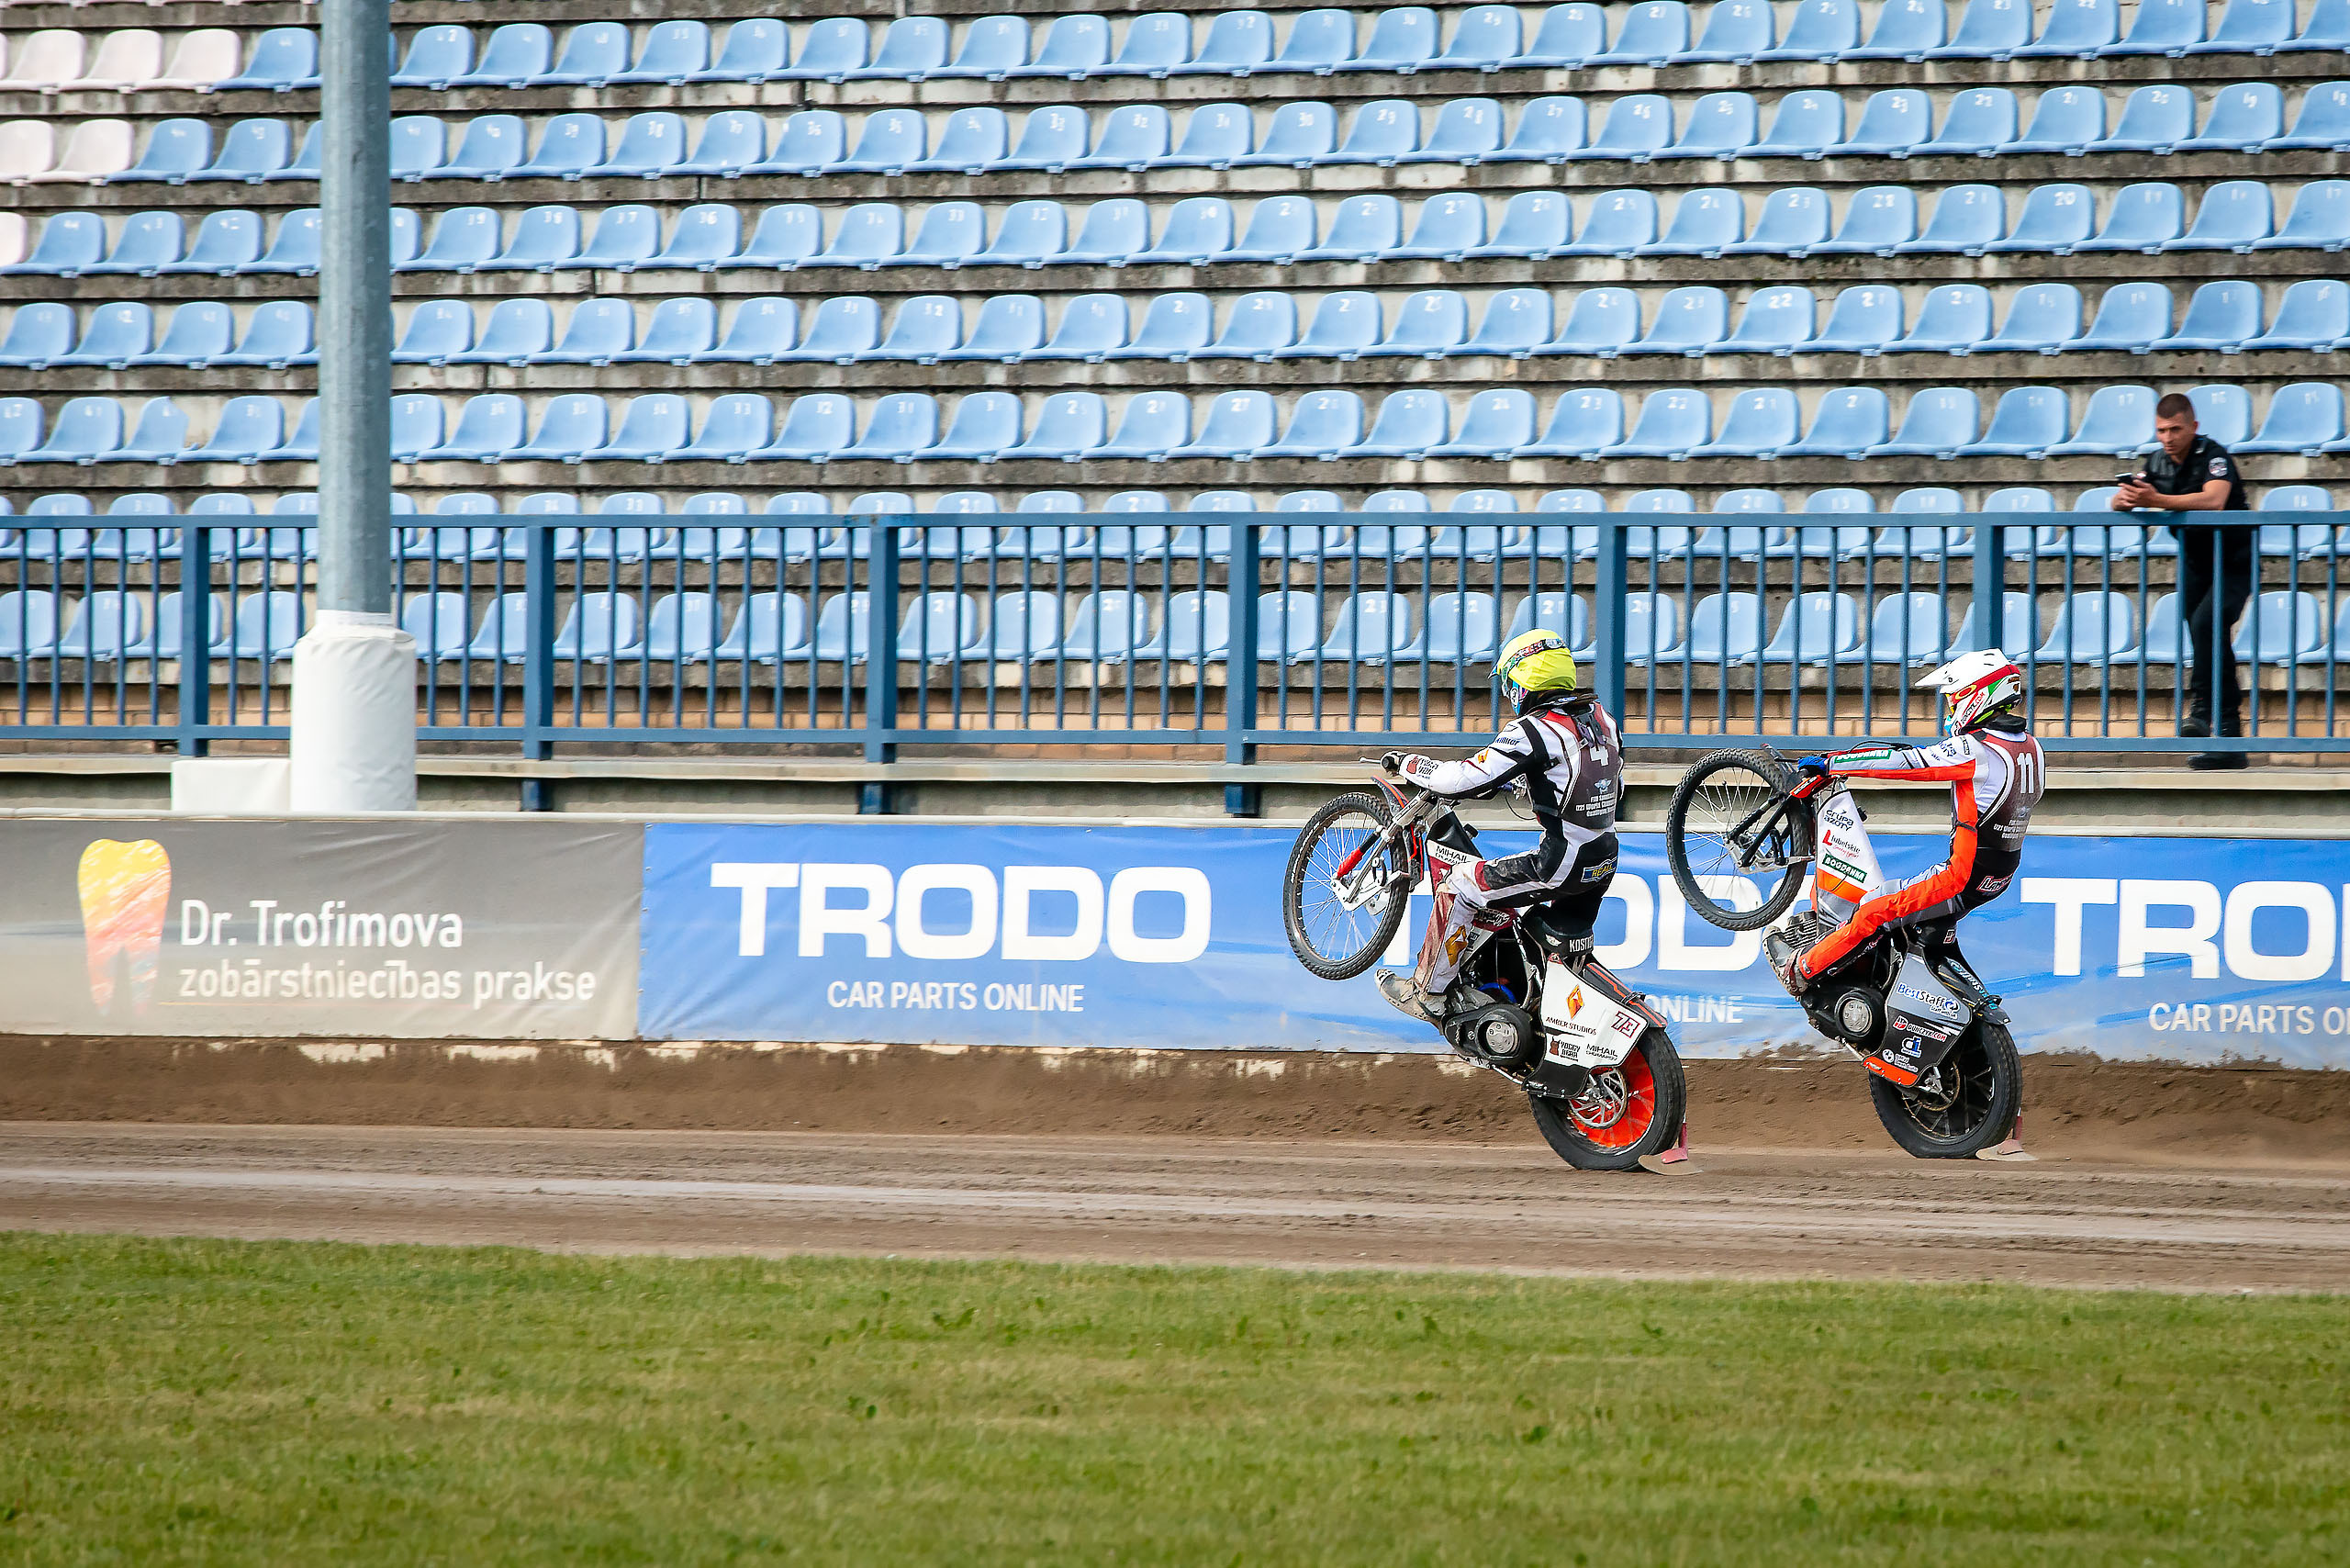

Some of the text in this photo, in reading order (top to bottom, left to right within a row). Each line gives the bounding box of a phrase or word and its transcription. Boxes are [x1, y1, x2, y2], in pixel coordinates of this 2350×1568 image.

[1590, 745, 1609, 767] 4
[2017, 752, 2034, 794] 11
[1436, 846, 1468, 863] MIHAIL
[1825, 857, 1864, 881] BOGDANKA
[181, 900, 463, 948] Dr. Trofimova
[711, 862, 1212, 963] TRODO
[180, 958, 597, 1010] zobārstniecības prakse
[827, 981, 1085, 1013] CAR PARTS ONLINE
[1897, 983, 1945, 1007] BestStaff
[1546, 1016, 1597, 1036] AMBER STUDIOS
[1611, 1011, 1640, 1038] 73
[2148, 1002, 2211, 1032] CAR
[2219, 1004, 2315, 1035] PARTS
[1586, 1043, 1618, 1057] MIHAIL
